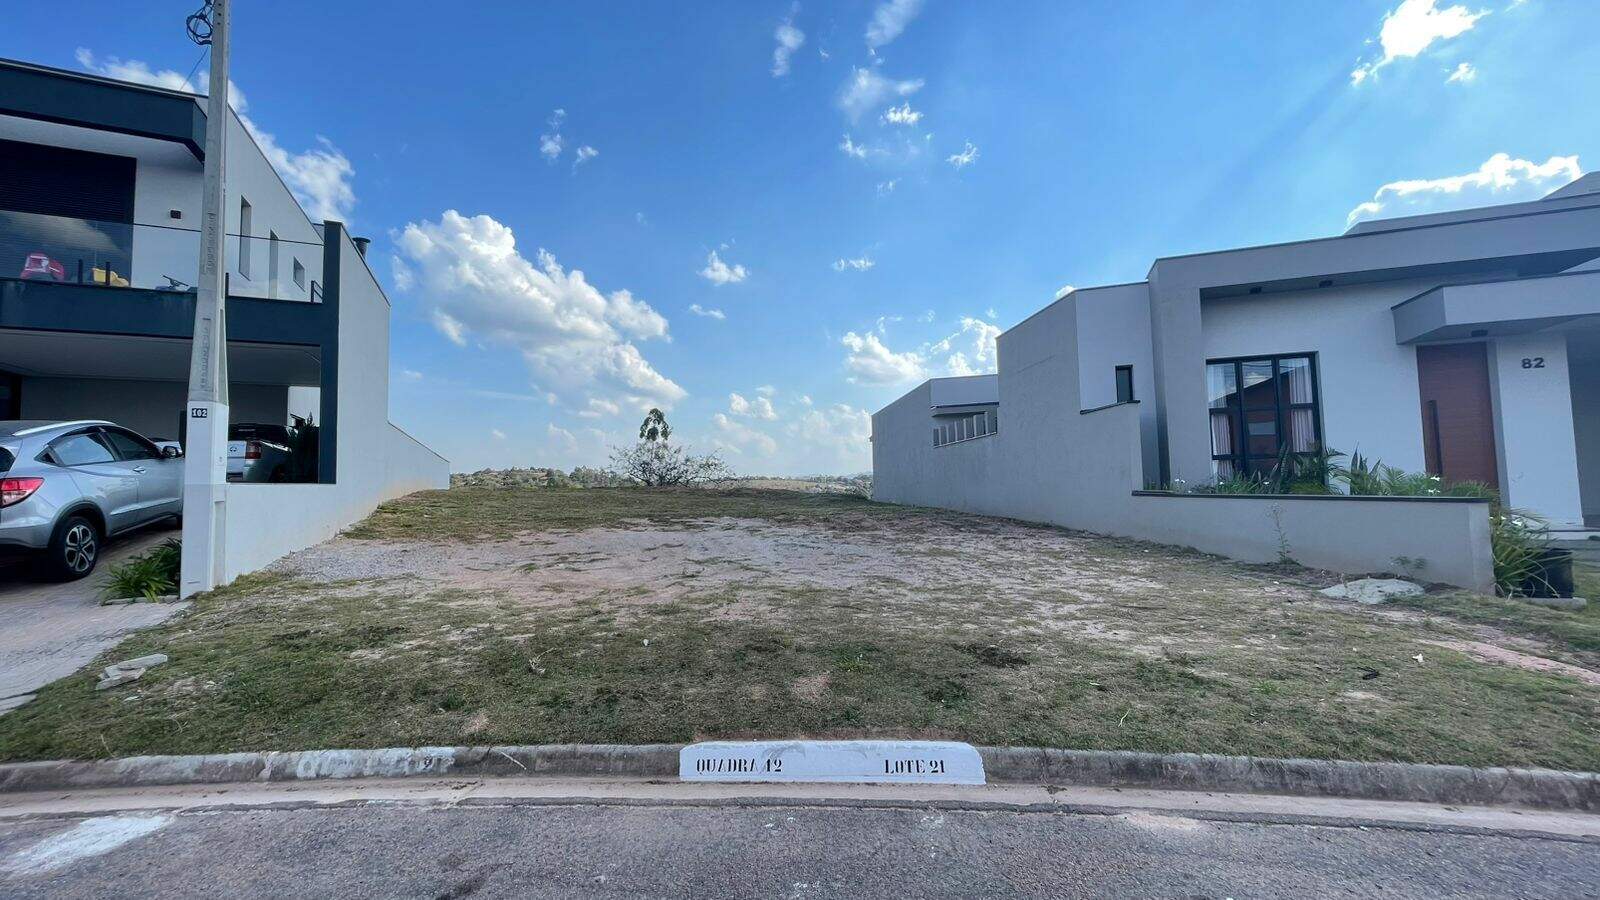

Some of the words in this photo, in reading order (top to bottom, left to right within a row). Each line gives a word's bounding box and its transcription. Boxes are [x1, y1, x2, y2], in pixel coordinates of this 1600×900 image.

[1521, 357, 1545, 369] 82
[192, 408, 207, 418] 102
[696, 758, 758, 774] QUADRA
[765, 758, 782, 773] 12
[884, 759, 926, 774] LOTE
[929, 759, 945, 774] 21
